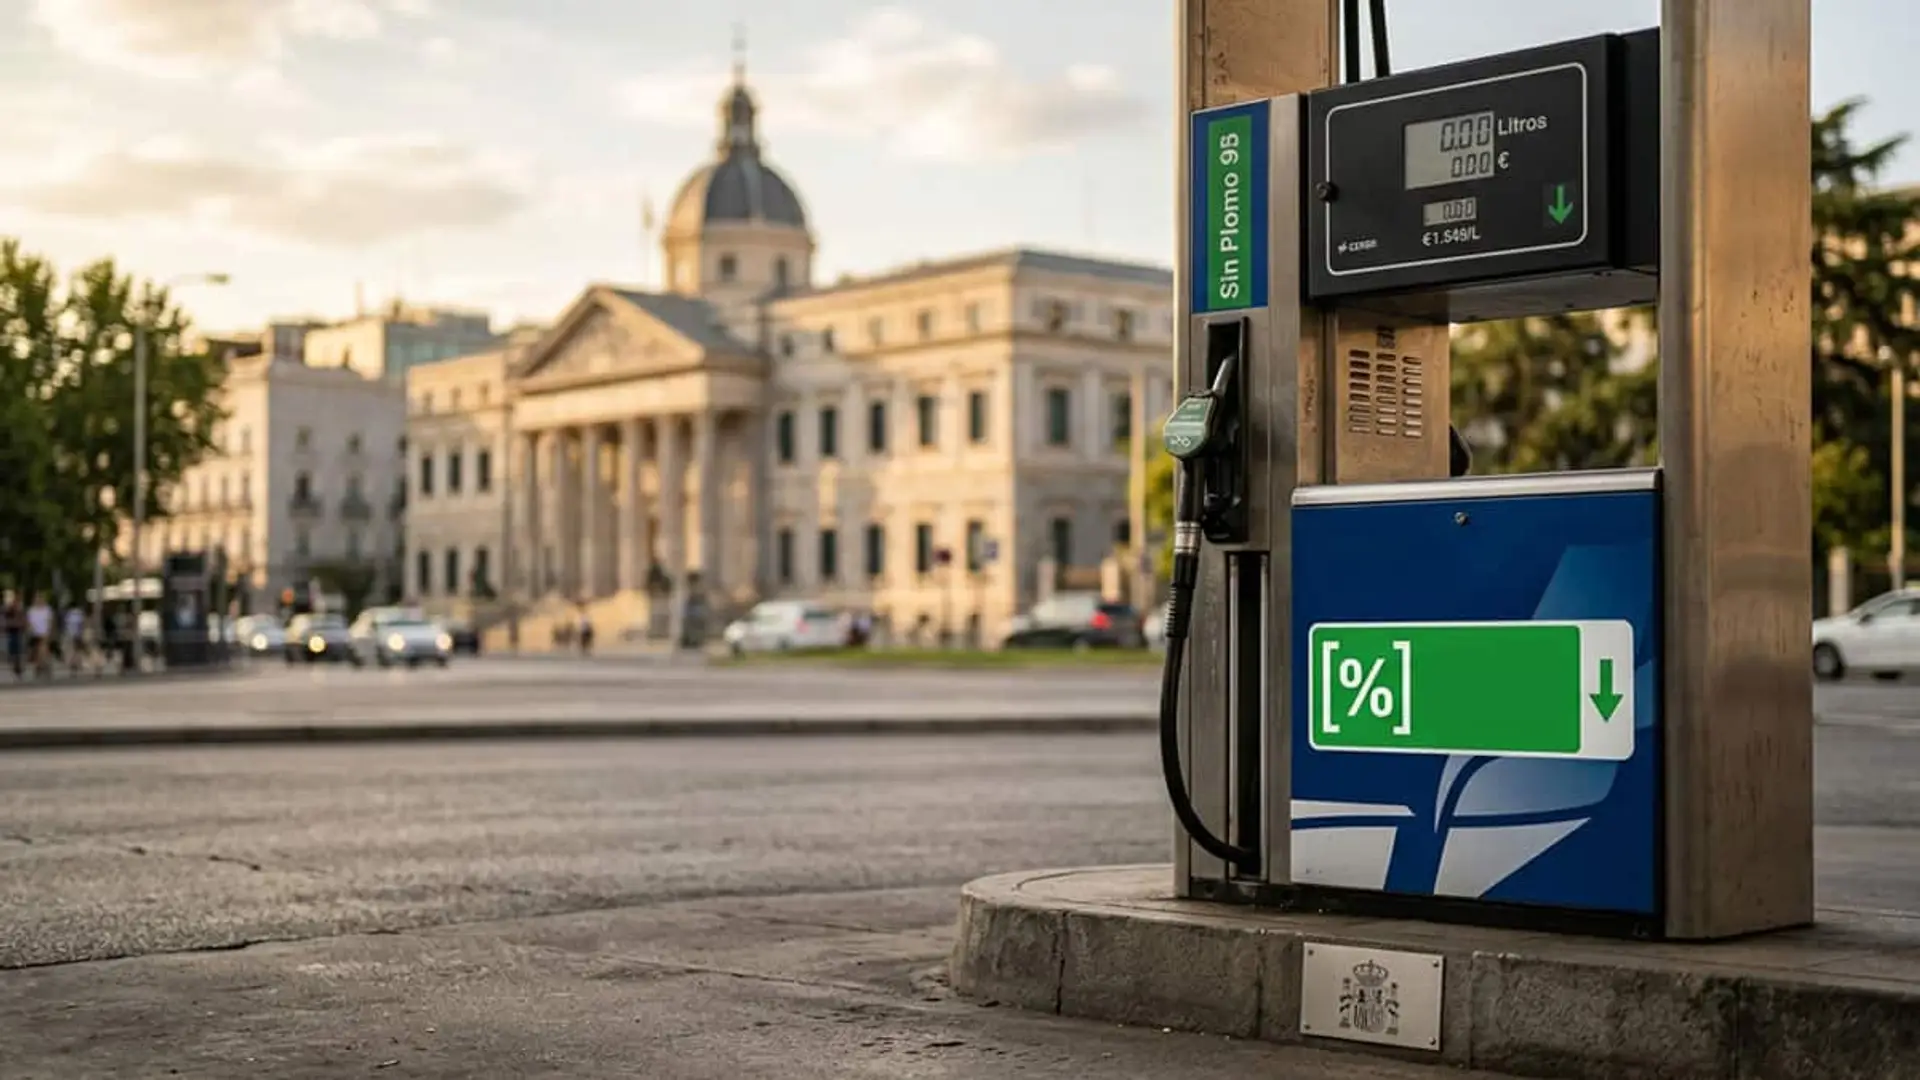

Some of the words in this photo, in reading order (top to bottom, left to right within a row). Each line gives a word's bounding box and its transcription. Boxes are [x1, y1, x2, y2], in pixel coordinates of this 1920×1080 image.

[1498, 115, 1547, 136] Litros
[1498, 151, 1510, 169] €
[1219, 172, 1239, 252] Plomo
[1219, 259, 1239, 299] Sin
